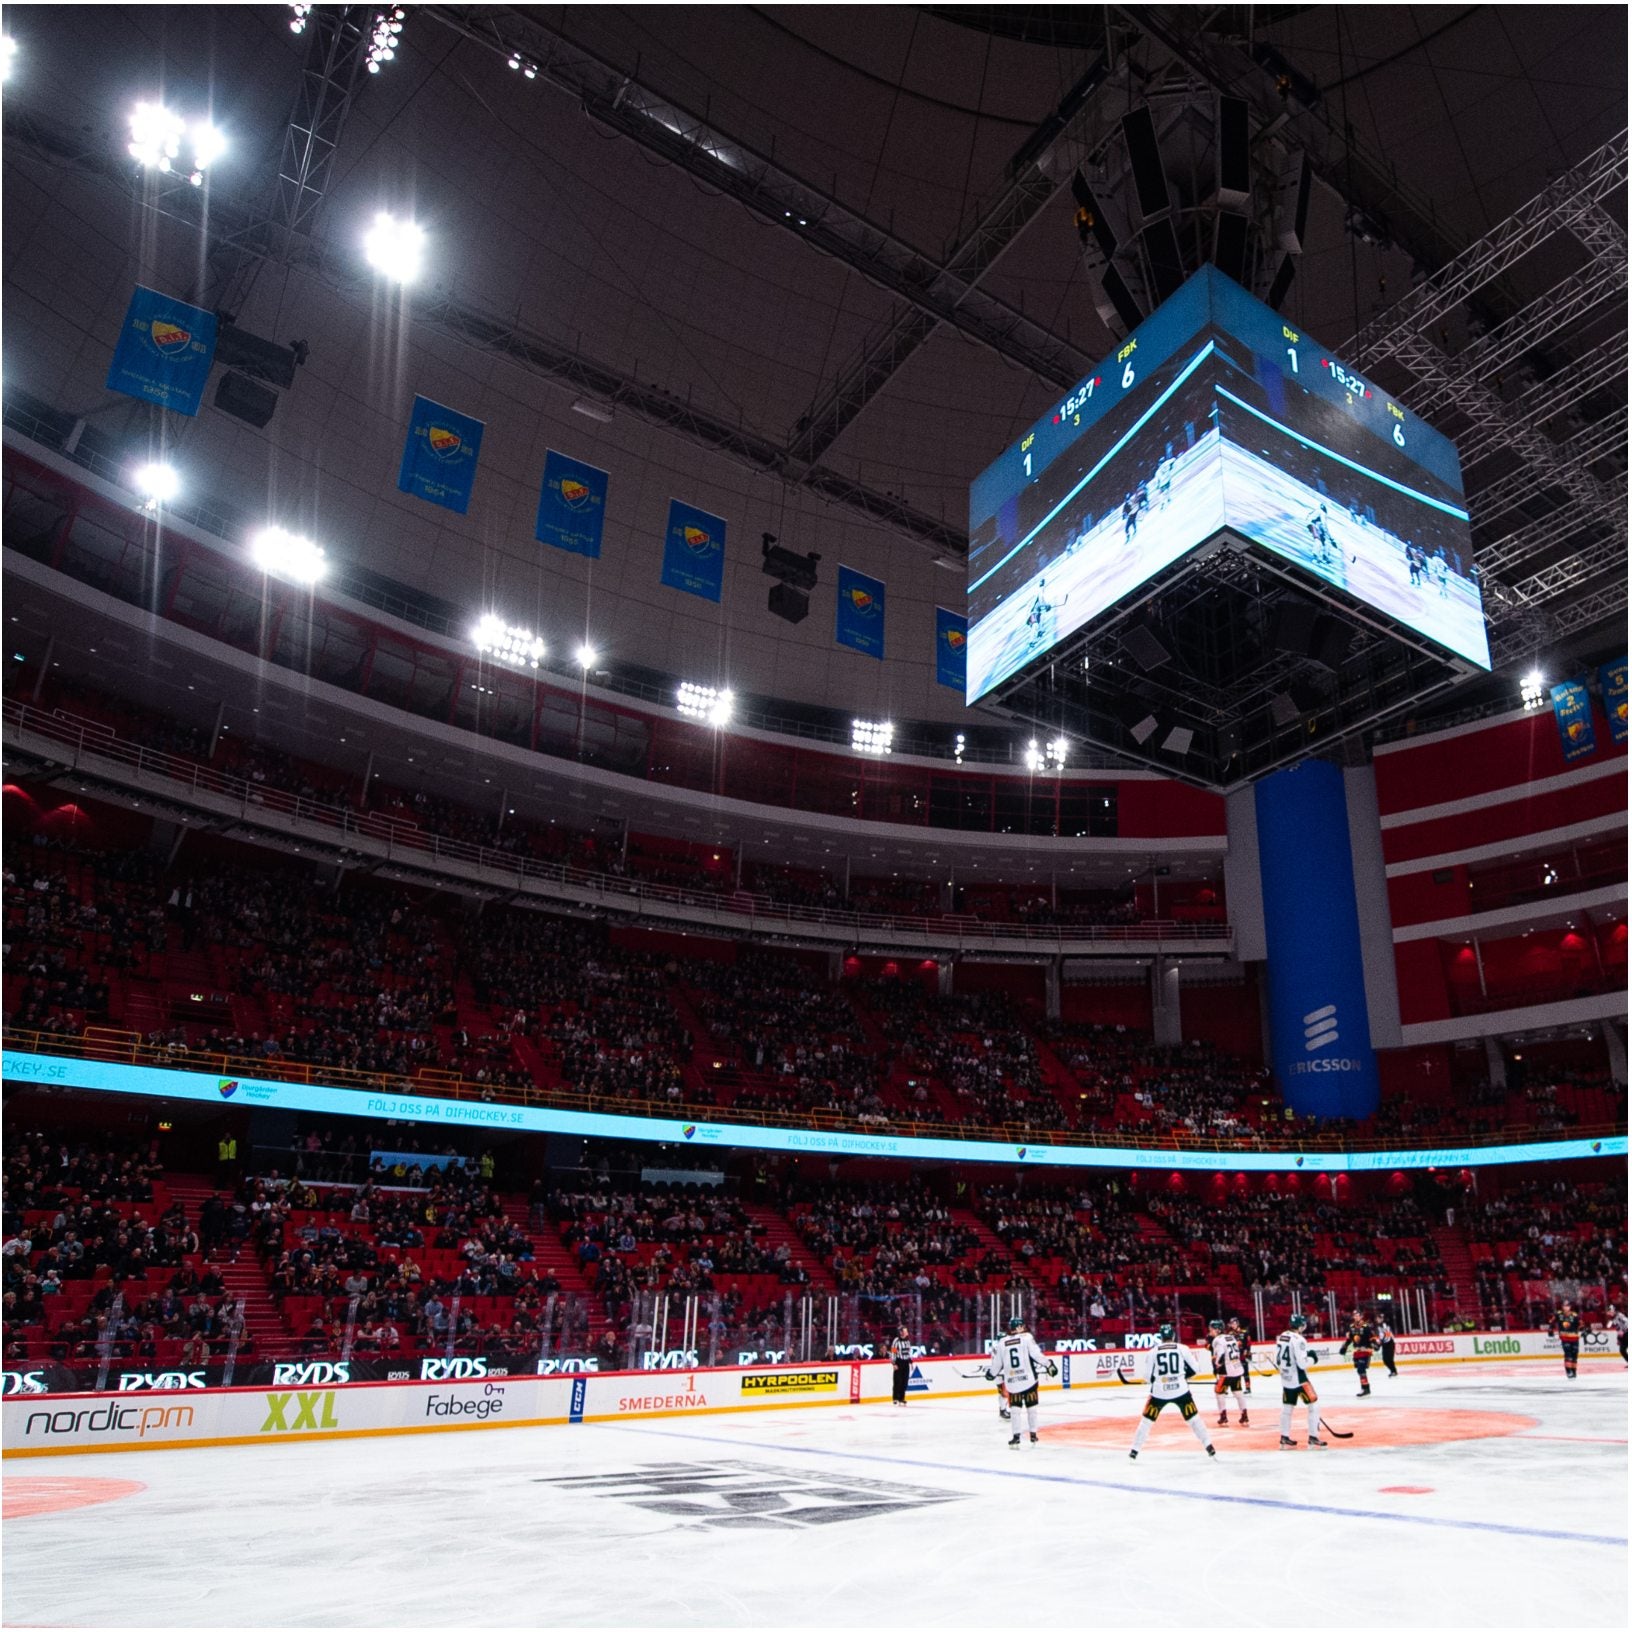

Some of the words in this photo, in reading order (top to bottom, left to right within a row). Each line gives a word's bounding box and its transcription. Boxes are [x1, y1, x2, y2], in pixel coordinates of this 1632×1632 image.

[1283, 326, 1299, 343] DIF
[1117, 338, 1138, 363] FBK
[1288, 348, 1298, 373] 1
[1122, 361, 1135, 388] 6
[1329, 362, 1365, 397] 15:27
[1060, 378, 1095, 421] 15:27
[1346, 392, 1353, 404] 3
[1073, 414, 1081, 426] 3
[1387, 402, 1405, 421] FBK
[1021, 433, 1035, 452] DIF
[1393, 424, 1405, 447] 6
[1023, 453, 1032, 476] 1
[1289, 1058, 1362, 1076] ERICSSON
[368, 1099, 396, 1113] FÖLJ
[399, 1102, 421, 1115] OSS
[425, 1103, 440, 1116] PÅ
[445, 1106, 525, 1124] DIFHOCKEY.SE
[1055, 1338, 1097, 1352] RYDS
[1125, 1333, 1162, 1349] RYDS
[1396, 1341, 1454, 1354] BAUHAUS
[1474, 1336, 1521, 1354] Lendo
[420, 1357, 488, 1380] RYDS
[643, 1350, 699, 1371] RYDS
[1009, 1347, 1021, 1369] 6
[1156, 1352, 1180, 1376] 50
[119, 1371, 206, 1391] RYDS
[272, 1362, 350, 1386] RYDS
[744, 1373, 836, 1387] HYRPOOLEN
[426, 1394, 503, 1419] Fabege
[573, 1381, 584, 1413] CCM
[619, 1394, 707, 1411] SMEDERNA
[260, 1391, 339, 1432] XXL
